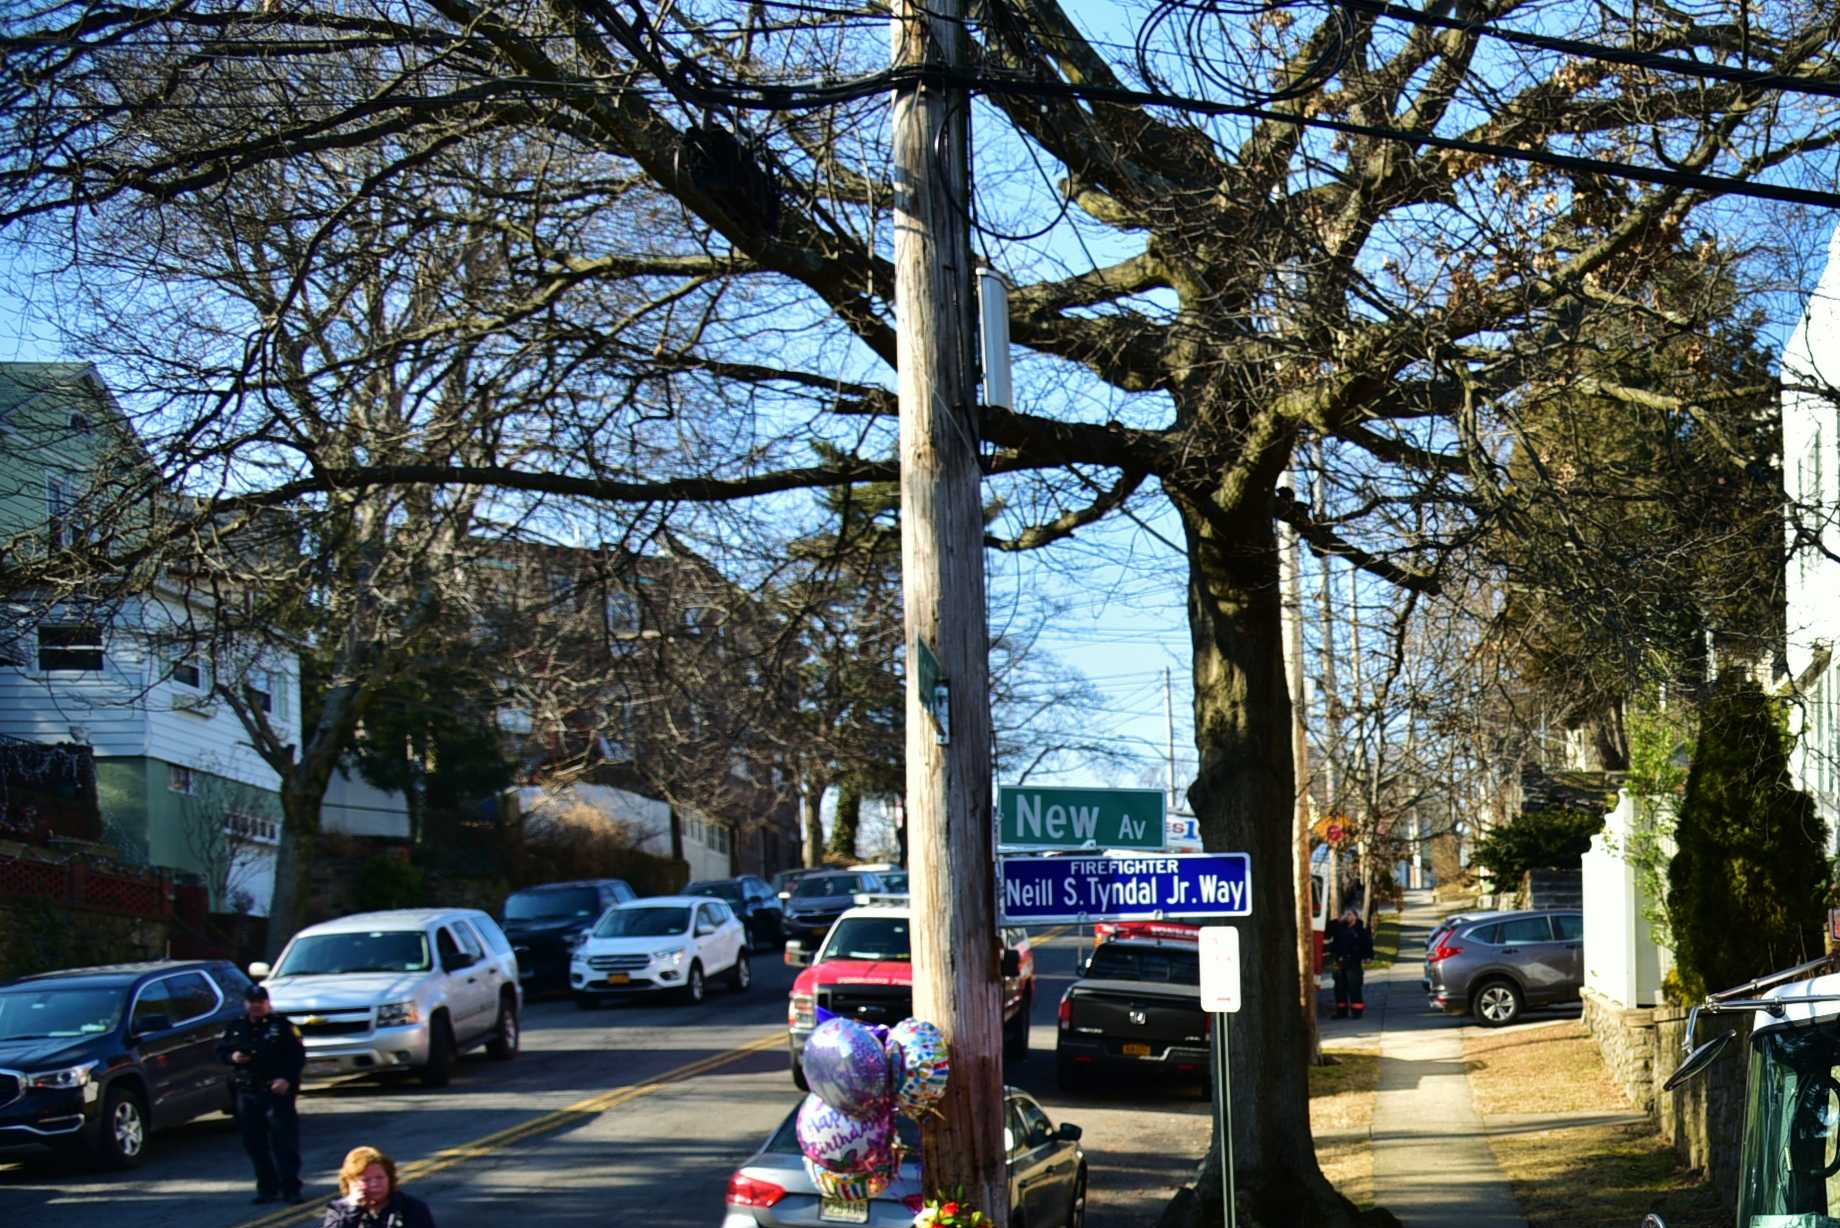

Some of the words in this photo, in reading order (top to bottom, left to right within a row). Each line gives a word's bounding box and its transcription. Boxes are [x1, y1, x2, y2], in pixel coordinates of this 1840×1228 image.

[1016, 794, 1100, 839] New
[1118, 814, 1147, 840] Av
[1070, 859, 1179, 875] FIREFIGHTER
[1005, 878, 1053, 907] Neill
[1063, 876, 1084, 907] S.
[1087, 876, 1157, 911] Tyndal
[1166, 874, 1197, 905] Jr.
[1199, 875, 1245, 911] Way
